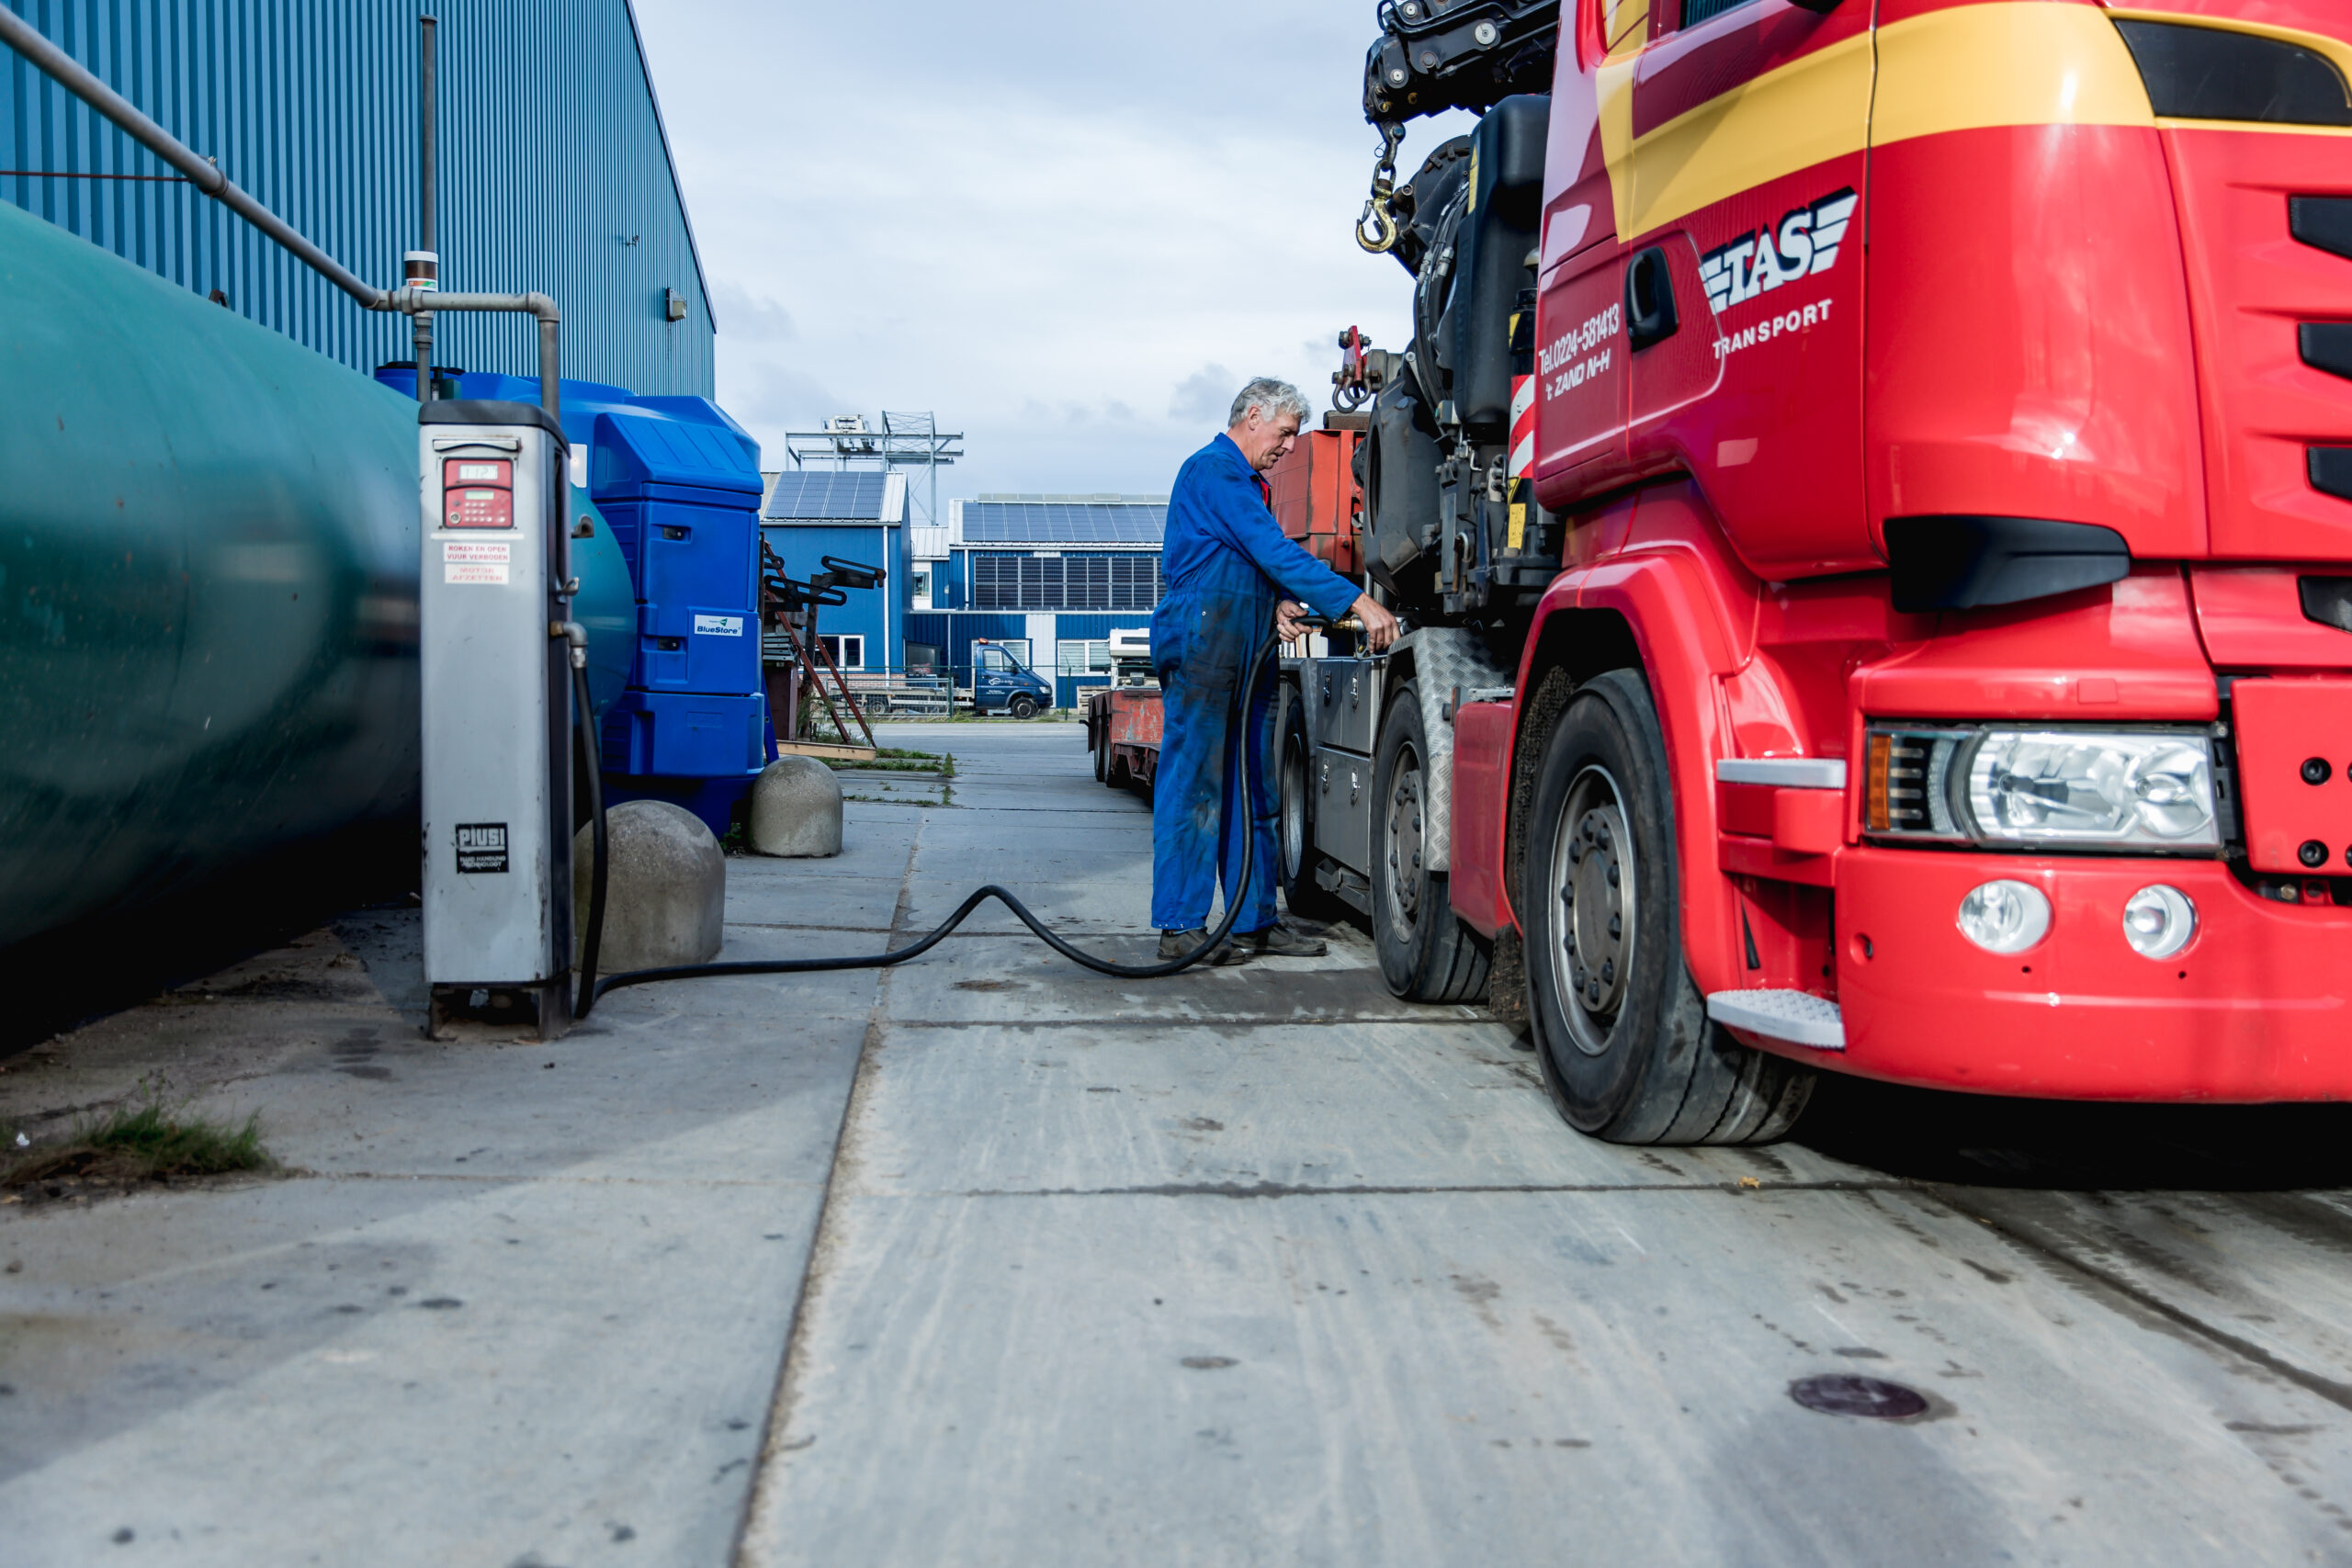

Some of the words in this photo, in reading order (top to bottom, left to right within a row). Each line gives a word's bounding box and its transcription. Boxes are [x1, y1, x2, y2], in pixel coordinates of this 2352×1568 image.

[1538, 302, 1620, 376] Tel.0224-581413
[1712, 299, 1833, 359] TRANSPORT
[1554, 362, 1585, 397] ZAND
[1586, 347, 1611, 380] N-H
[697, 626, 738, 634] BlueStore
[458, 828, 505, 846] PIUSI
